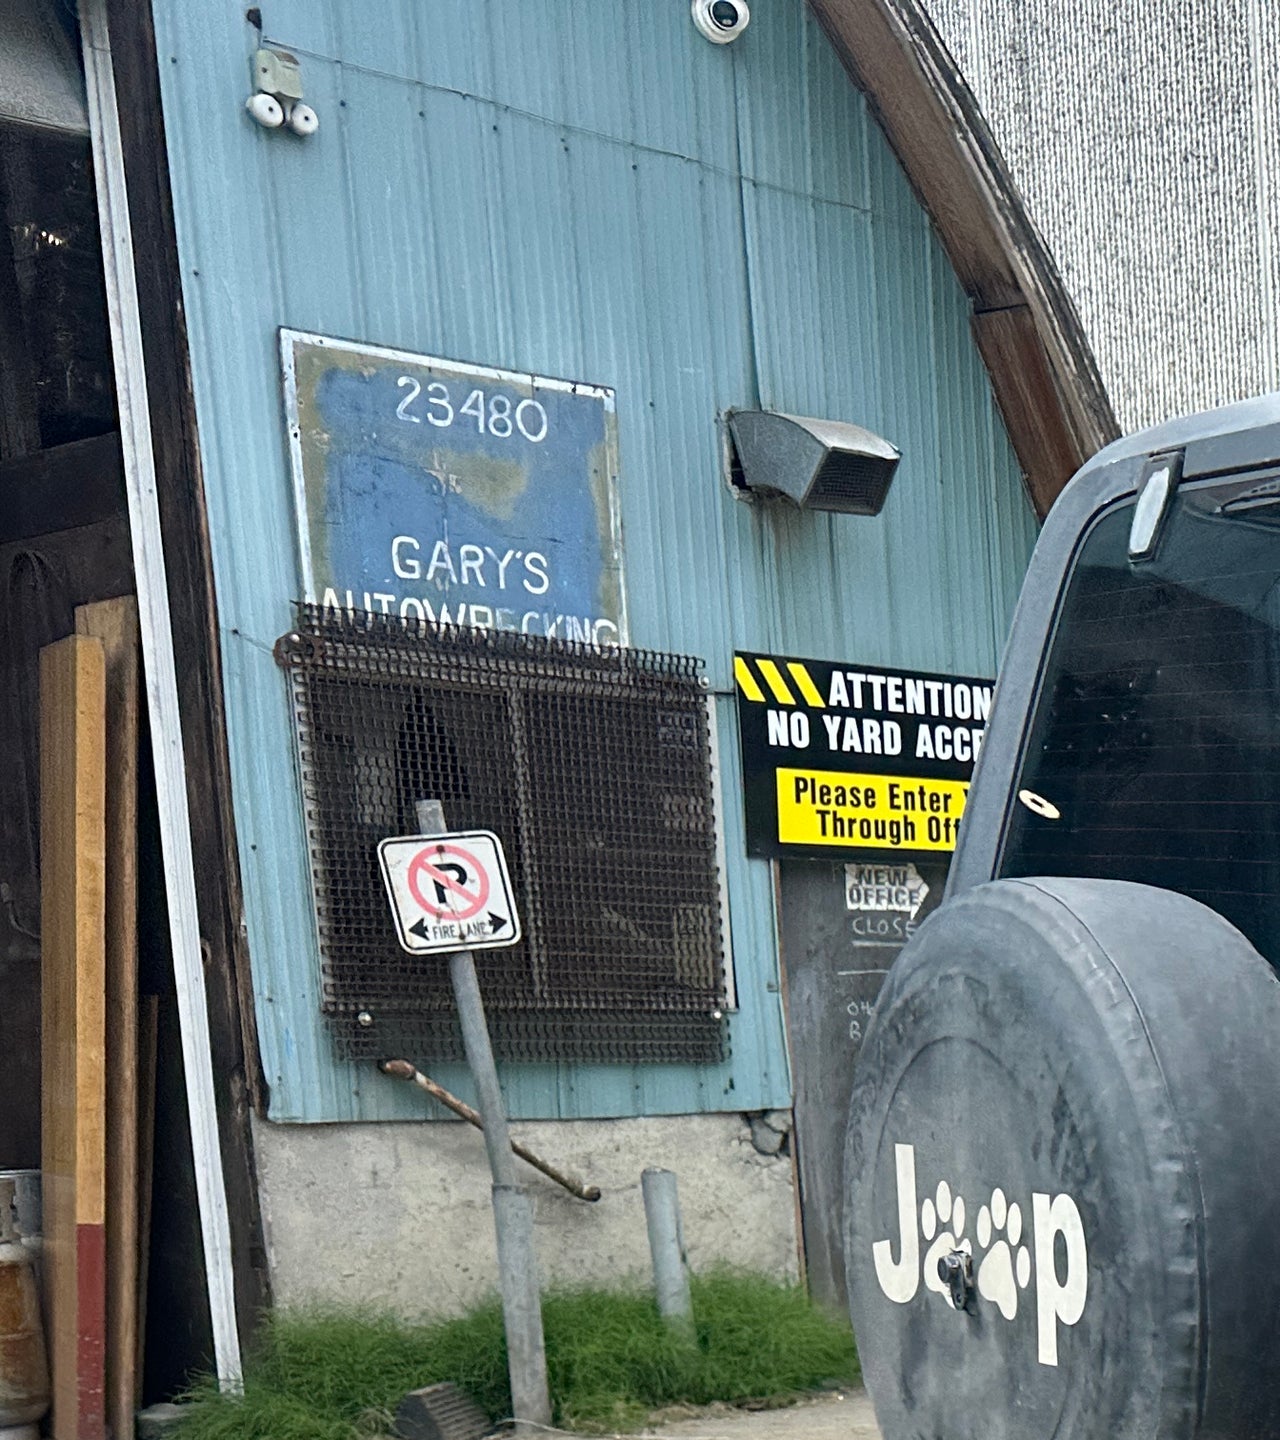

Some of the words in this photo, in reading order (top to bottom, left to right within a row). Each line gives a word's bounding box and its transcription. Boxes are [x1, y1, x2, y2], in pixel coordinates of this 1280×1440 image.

[395, 375, 549, 443] 23480
[391, 534, 550, 595] GARY'S
[767, 709, 810, 749] NO
[822, 714, 902, 756] YARD
[794, 776, 876, 809] Please
[888, 782, 952, 813] Enter
[816, 810, 915, 845] Through
[857, 866, 908, 886] NEW
[849, 884, 920, 906] OFFICE
[432, 923, 455, 940] FIRE
